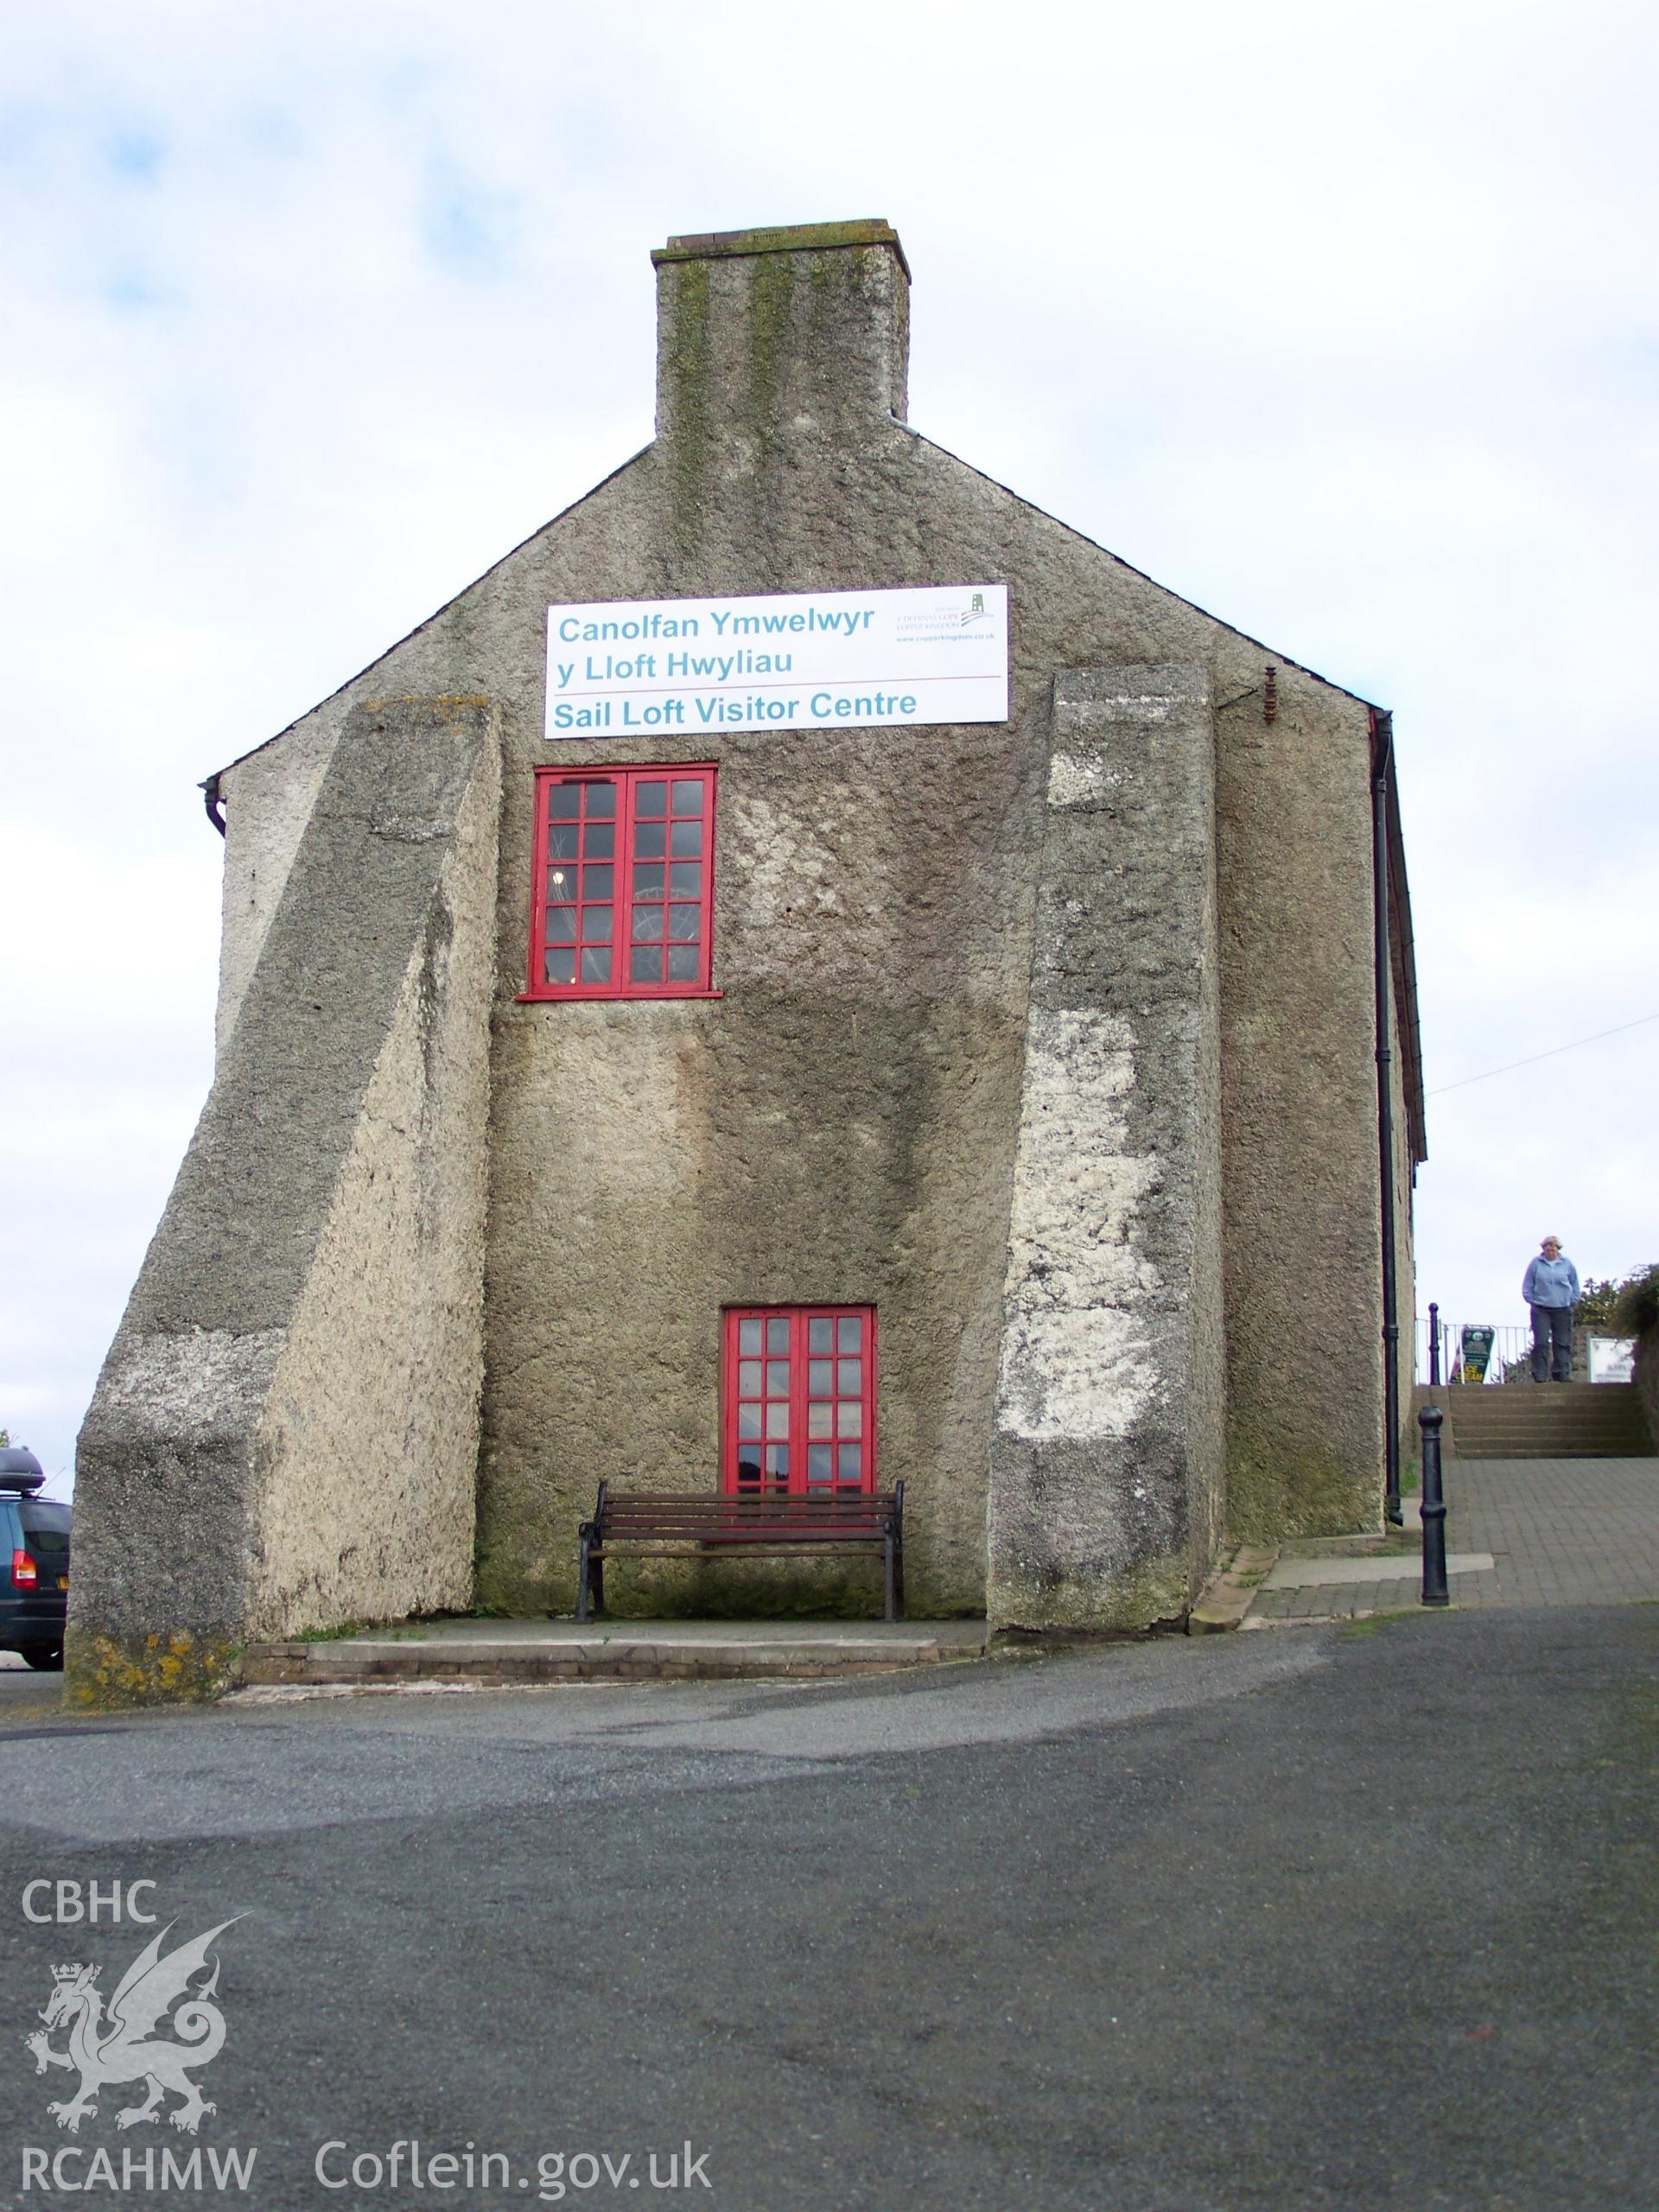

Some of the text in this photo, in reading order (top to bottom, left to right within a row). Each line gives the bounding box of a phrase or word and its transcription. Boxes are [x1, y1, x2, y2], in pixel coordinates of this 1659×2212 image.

[559, 607, 874, 642] Canolfan Ymwelwyr
[557, 650, 792, 688] y Lloft Hwyliau
[554, 691, 917, 728] Sail Loft Visitor Centre
